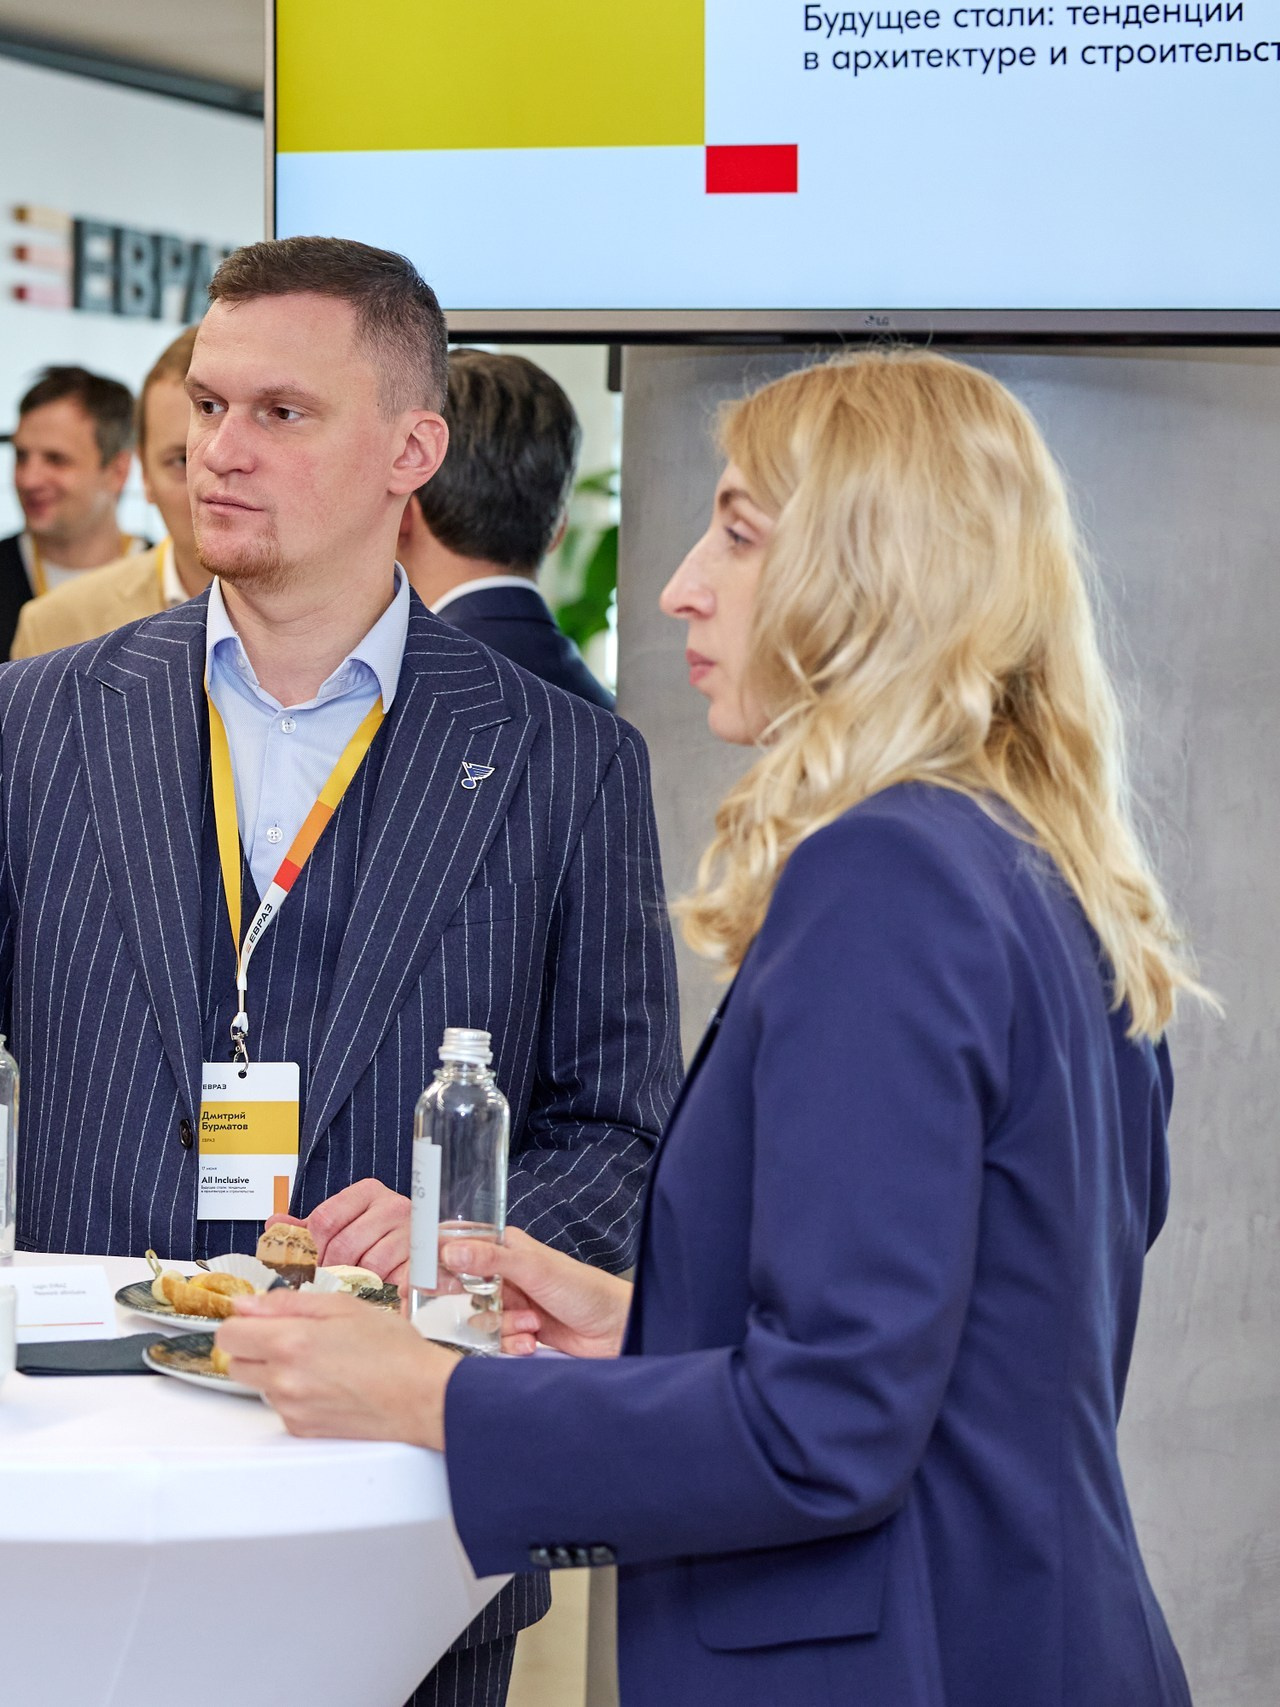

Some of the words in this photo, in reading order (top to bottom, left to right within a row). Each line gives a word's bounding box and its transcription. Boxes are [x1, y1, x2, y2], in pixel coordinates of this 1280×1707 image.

[804, 4, 941, 39] Будущее
[953, 7, 1055, 28] стали:
[1066, 2, 1244, 30] тенденции
[803, 52, 820, 71] в
[832, 46, 1037, 77] архитектуре
[1050, 46, 1068, 66] и
[248, 903, 274, 944] ЕВРАЗ
[201, 1111, 246, 1122] Дмитрий
[201, 1121, 249, 1132] Бурматов
[201, 1176, 213, 1184] All
[214, 1176, 250, 1184] Inclusive
